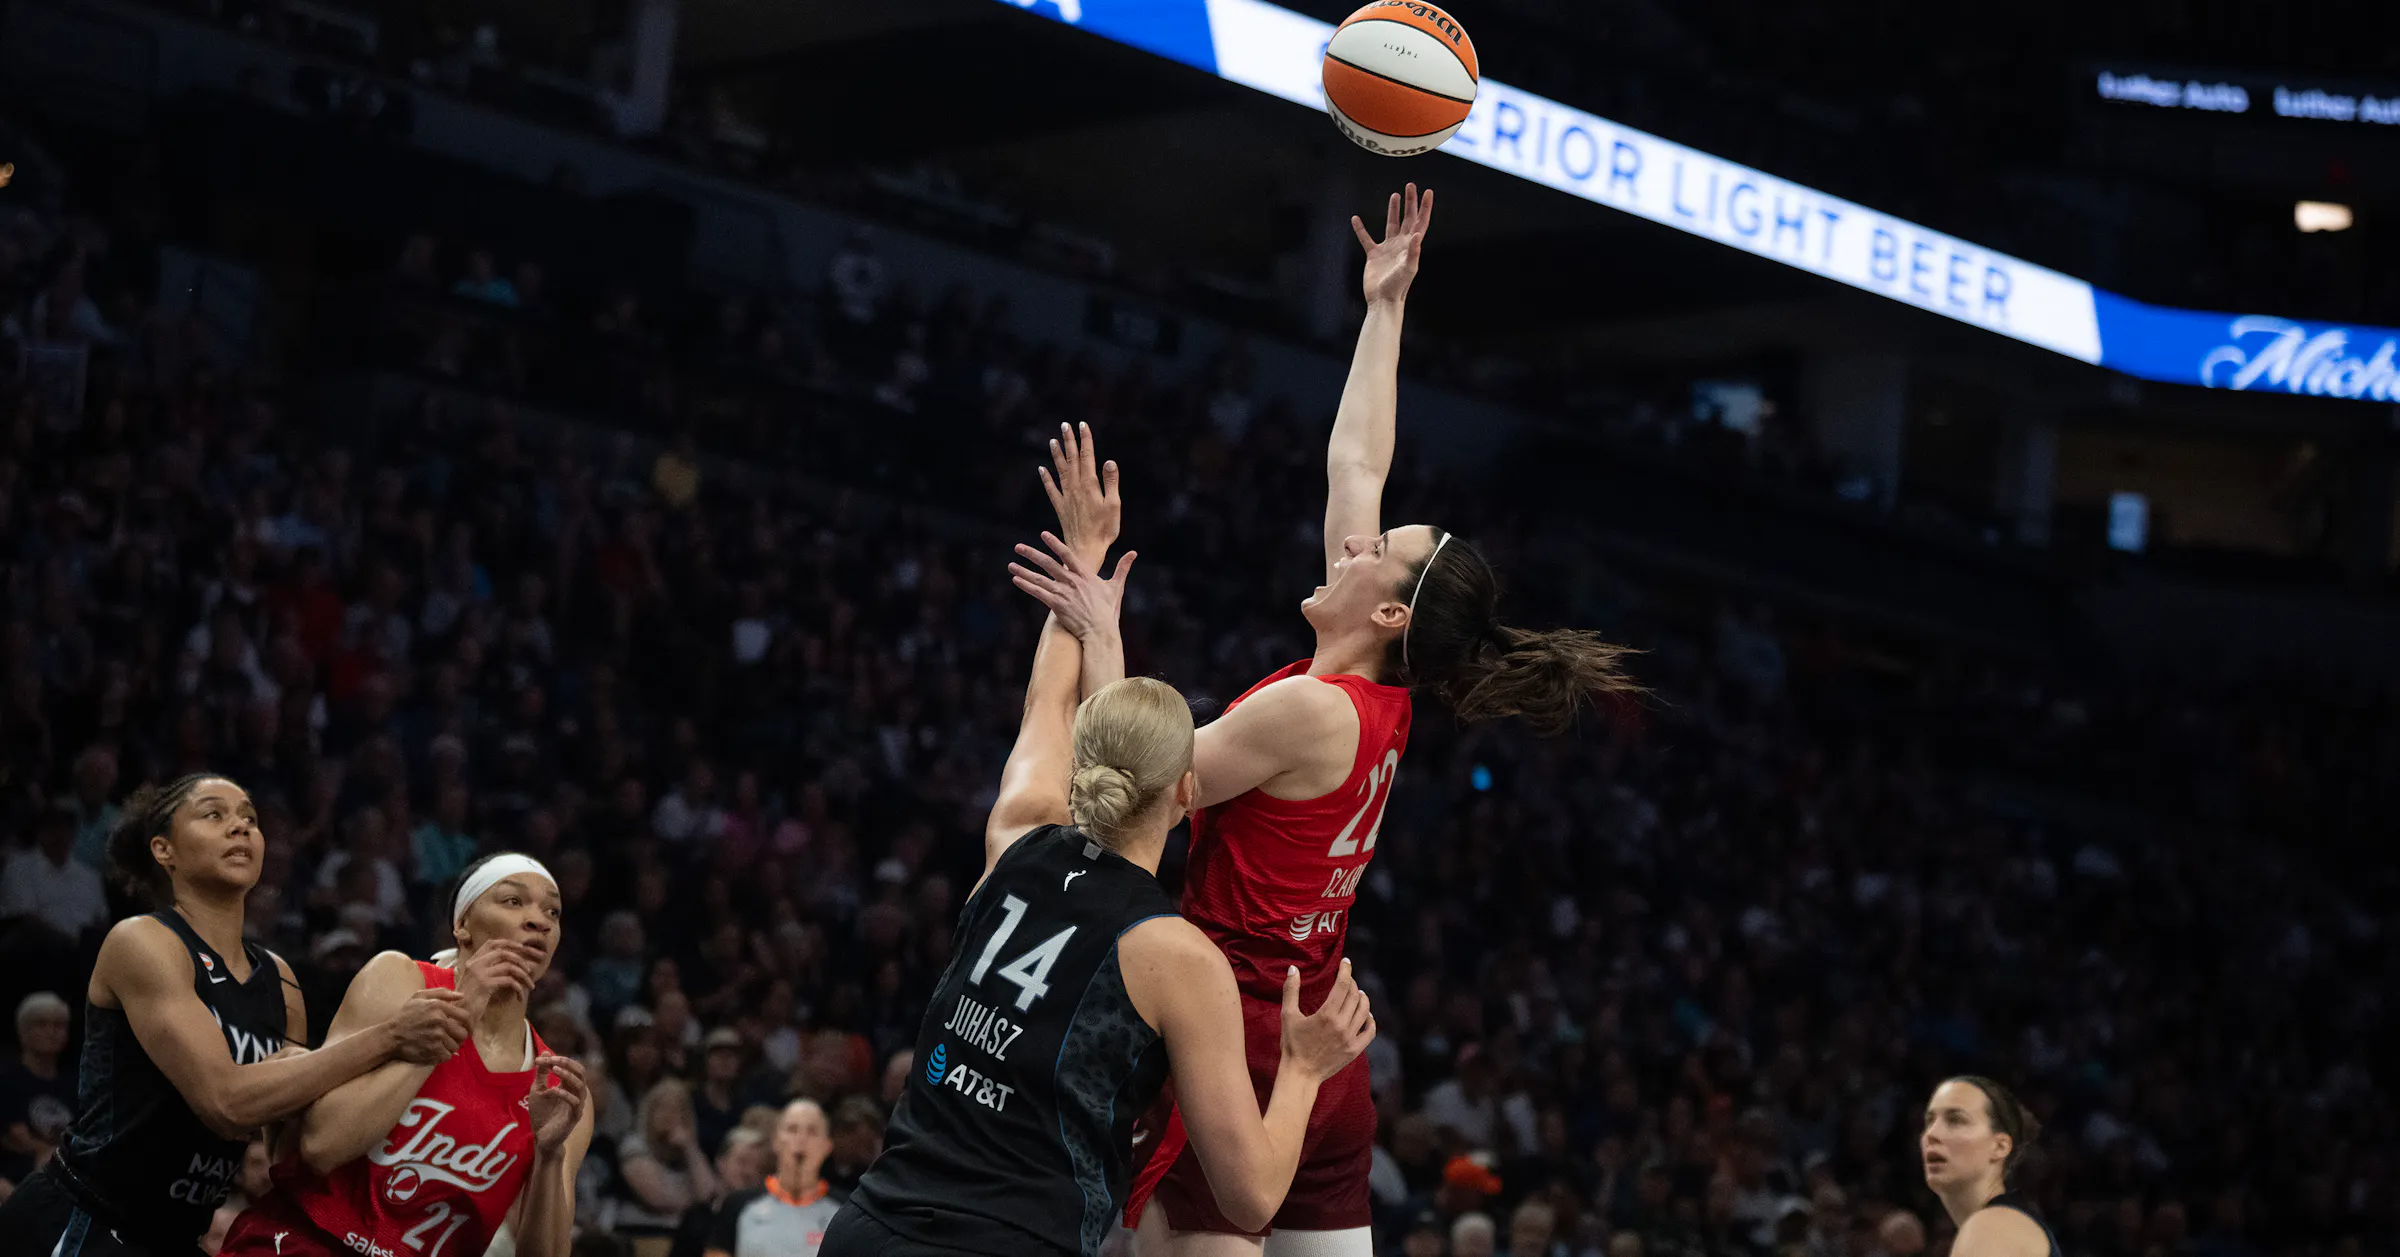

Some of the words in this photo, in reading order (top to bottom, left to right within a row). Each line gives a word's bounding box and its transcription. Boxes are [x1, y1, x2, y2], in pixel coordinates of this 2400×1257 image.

[1671, 161, 1842, 262] LIGHT
[1868, 226, 2013, 324] BEER
[2199, 314, 2400, 404] Mich
[1327, 748, 1399, 858] 22
[968, 892, 1079, 1013] 14
[1317, 909, 1343, 933] AT
[944, 994, 1024, 1062] JUHÁSZ
[944, 1063, 1015, 1112] AT&T
[187, 1152, 241, 1181] NAY
[367, 1097, 519, 1192] Indy
[400, 1201, 470, 1257] 21
